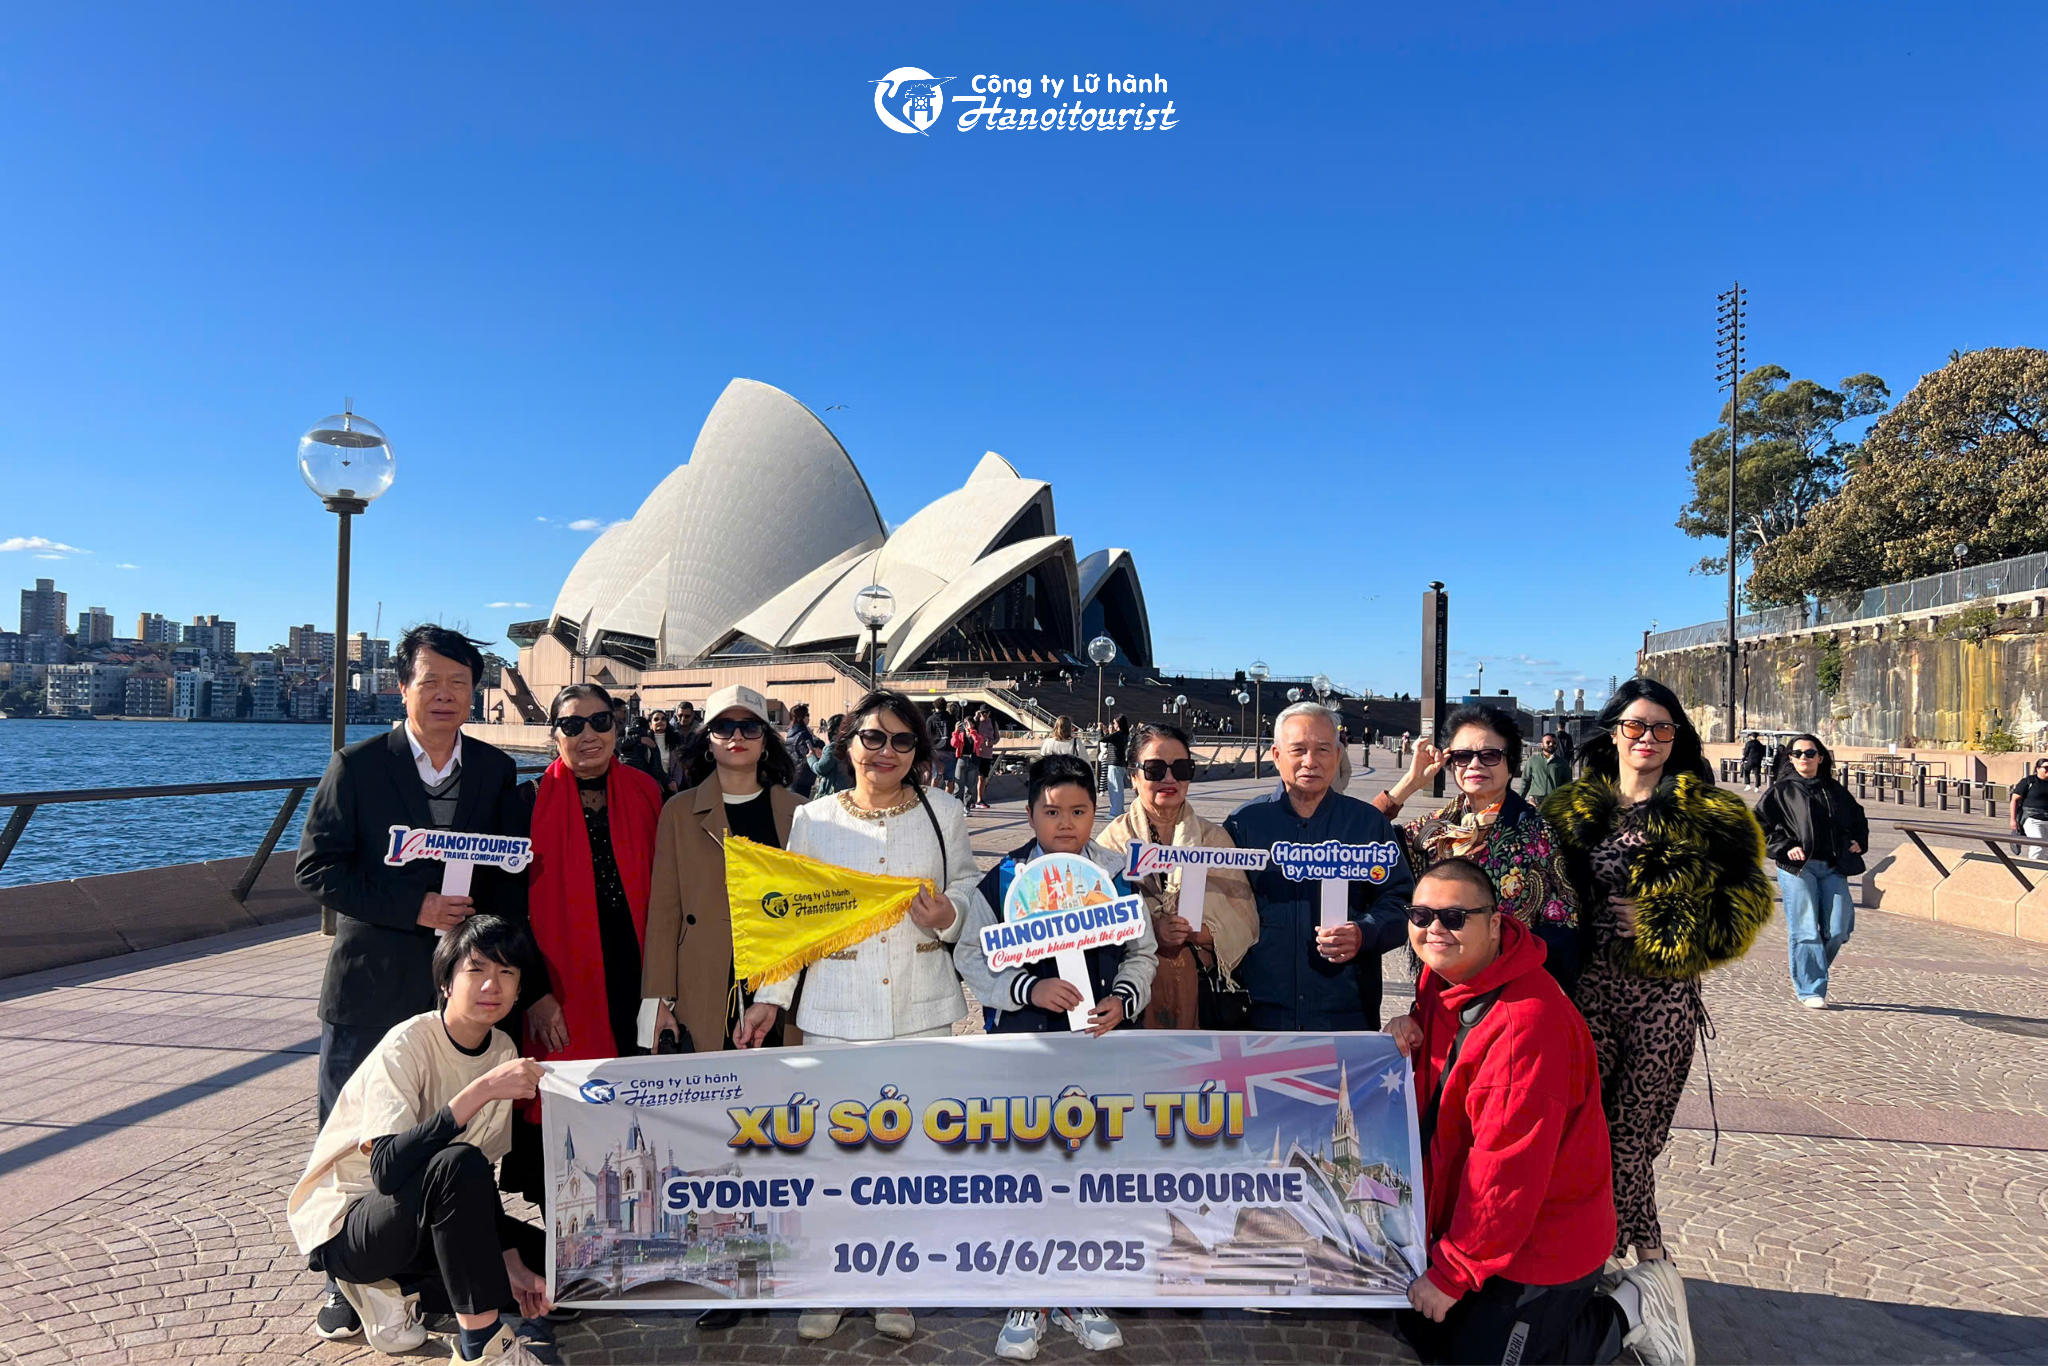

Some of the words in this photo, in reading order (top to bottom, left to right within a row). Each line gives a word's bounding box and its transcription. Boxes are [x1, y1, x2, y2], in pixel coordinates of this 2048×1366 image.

[389, 830, 407, 863] I
[425, 833, 529, 855] HANOITOURIST
[444, 852, 469, 860] TRAVEL
[471, 853, 505, 863] COMPANY
[1127, 843, 1143, 876] I
[1158, 849, 1266, 867] HANOITOURIST
[1276, 844, 1396, 863] Hanoitourist
[1286, 865, 1303, 878] By
[1306, 865, 1337, 877] Your
[1340, 864, 1369, 877] Side
[792, 898, 858, 917] Hanoitourist
[794, 893, 812, 902] Công
[814, 892, 821, 900] ty
[984, 899, 1140, 952] HANOITOURIST
[1026, 945, 1044, 960] bạn
[1047, 940, 1075, 954] khám
[1077, 935, 1097, 950] phá
[1099, 929, 1115, 942] thế
[630, 1078, 664, 1090] Công
[669, 1077, 681, 1088] ty
[686, 1074, 701, 1085] Lữ
[705, 1072, 738, 1084] hành
[619, 1085, 746, 1107] Hanoitourist
[727, 1092, 820, 1148] XỨ
[828, 1083, 913, 1147] SỞ
[922, 1084, 1135, 1150] CHUỘT
[1143, 1079, 1245, 1140] TÚI
[667, 1178, 815, 1210] SYDNEY
[850, 1174, 1043, 1206] CANBERRA
[1079, 1172, 1304, 1203] MELBOURNE
[834, 1240, 920, 1276] 10/6
[956, 1239, 1146, 1276] 16/6/2025
